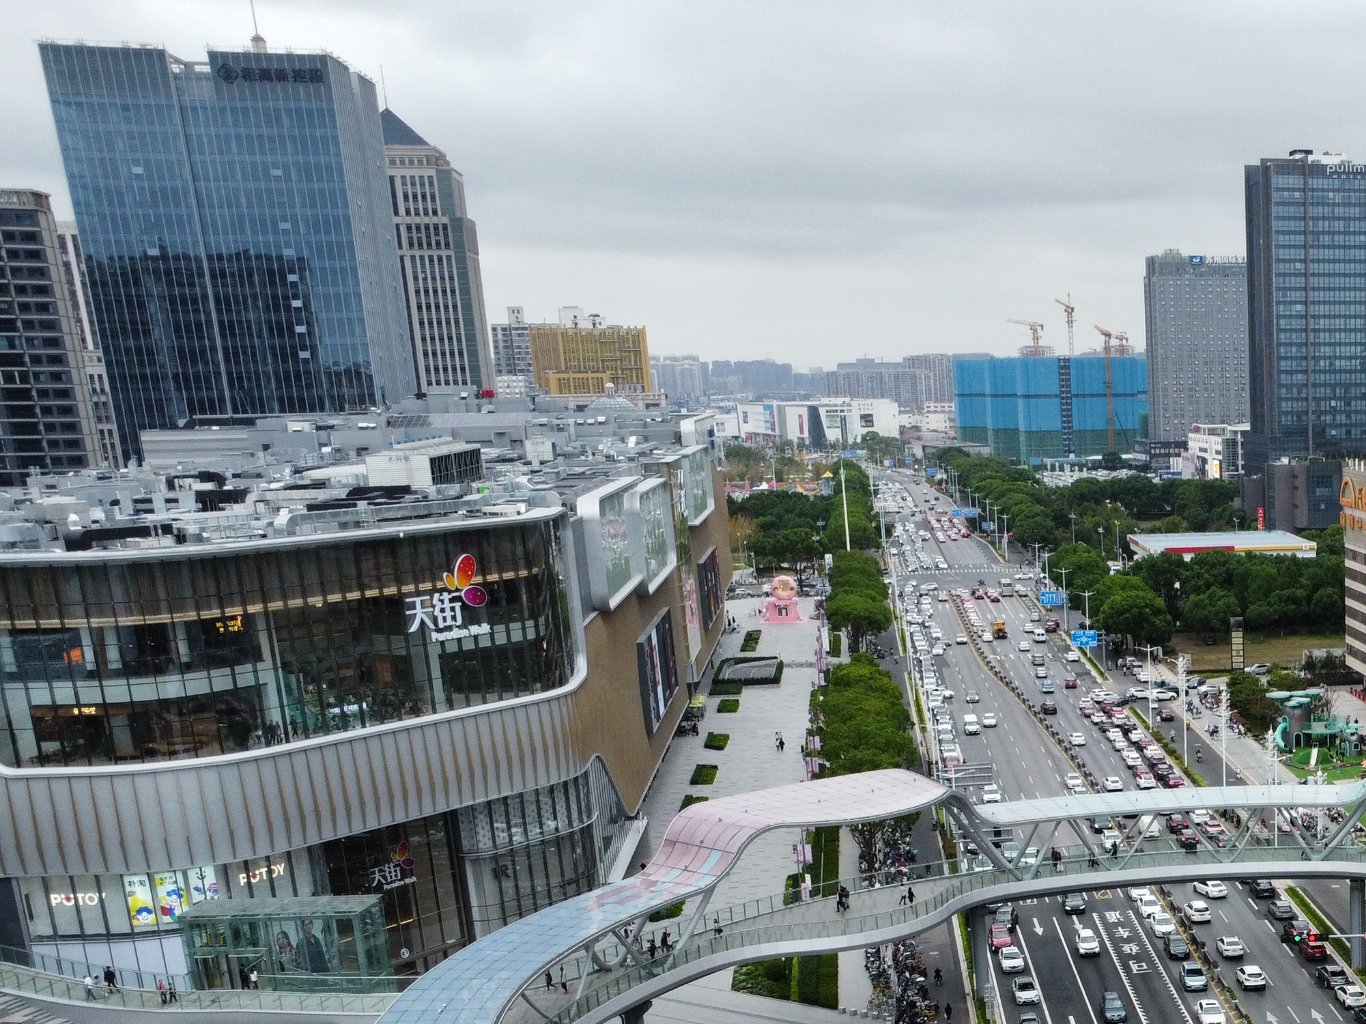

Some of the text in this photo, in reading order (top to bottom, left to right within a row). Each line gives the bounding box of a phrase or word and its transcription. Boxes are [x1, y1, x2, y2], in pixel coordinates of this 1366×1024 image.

[405, 592, 463, 633] 天街
[468, 623, 492, 636] Walk
[370, 862, 401, 887] 天街
